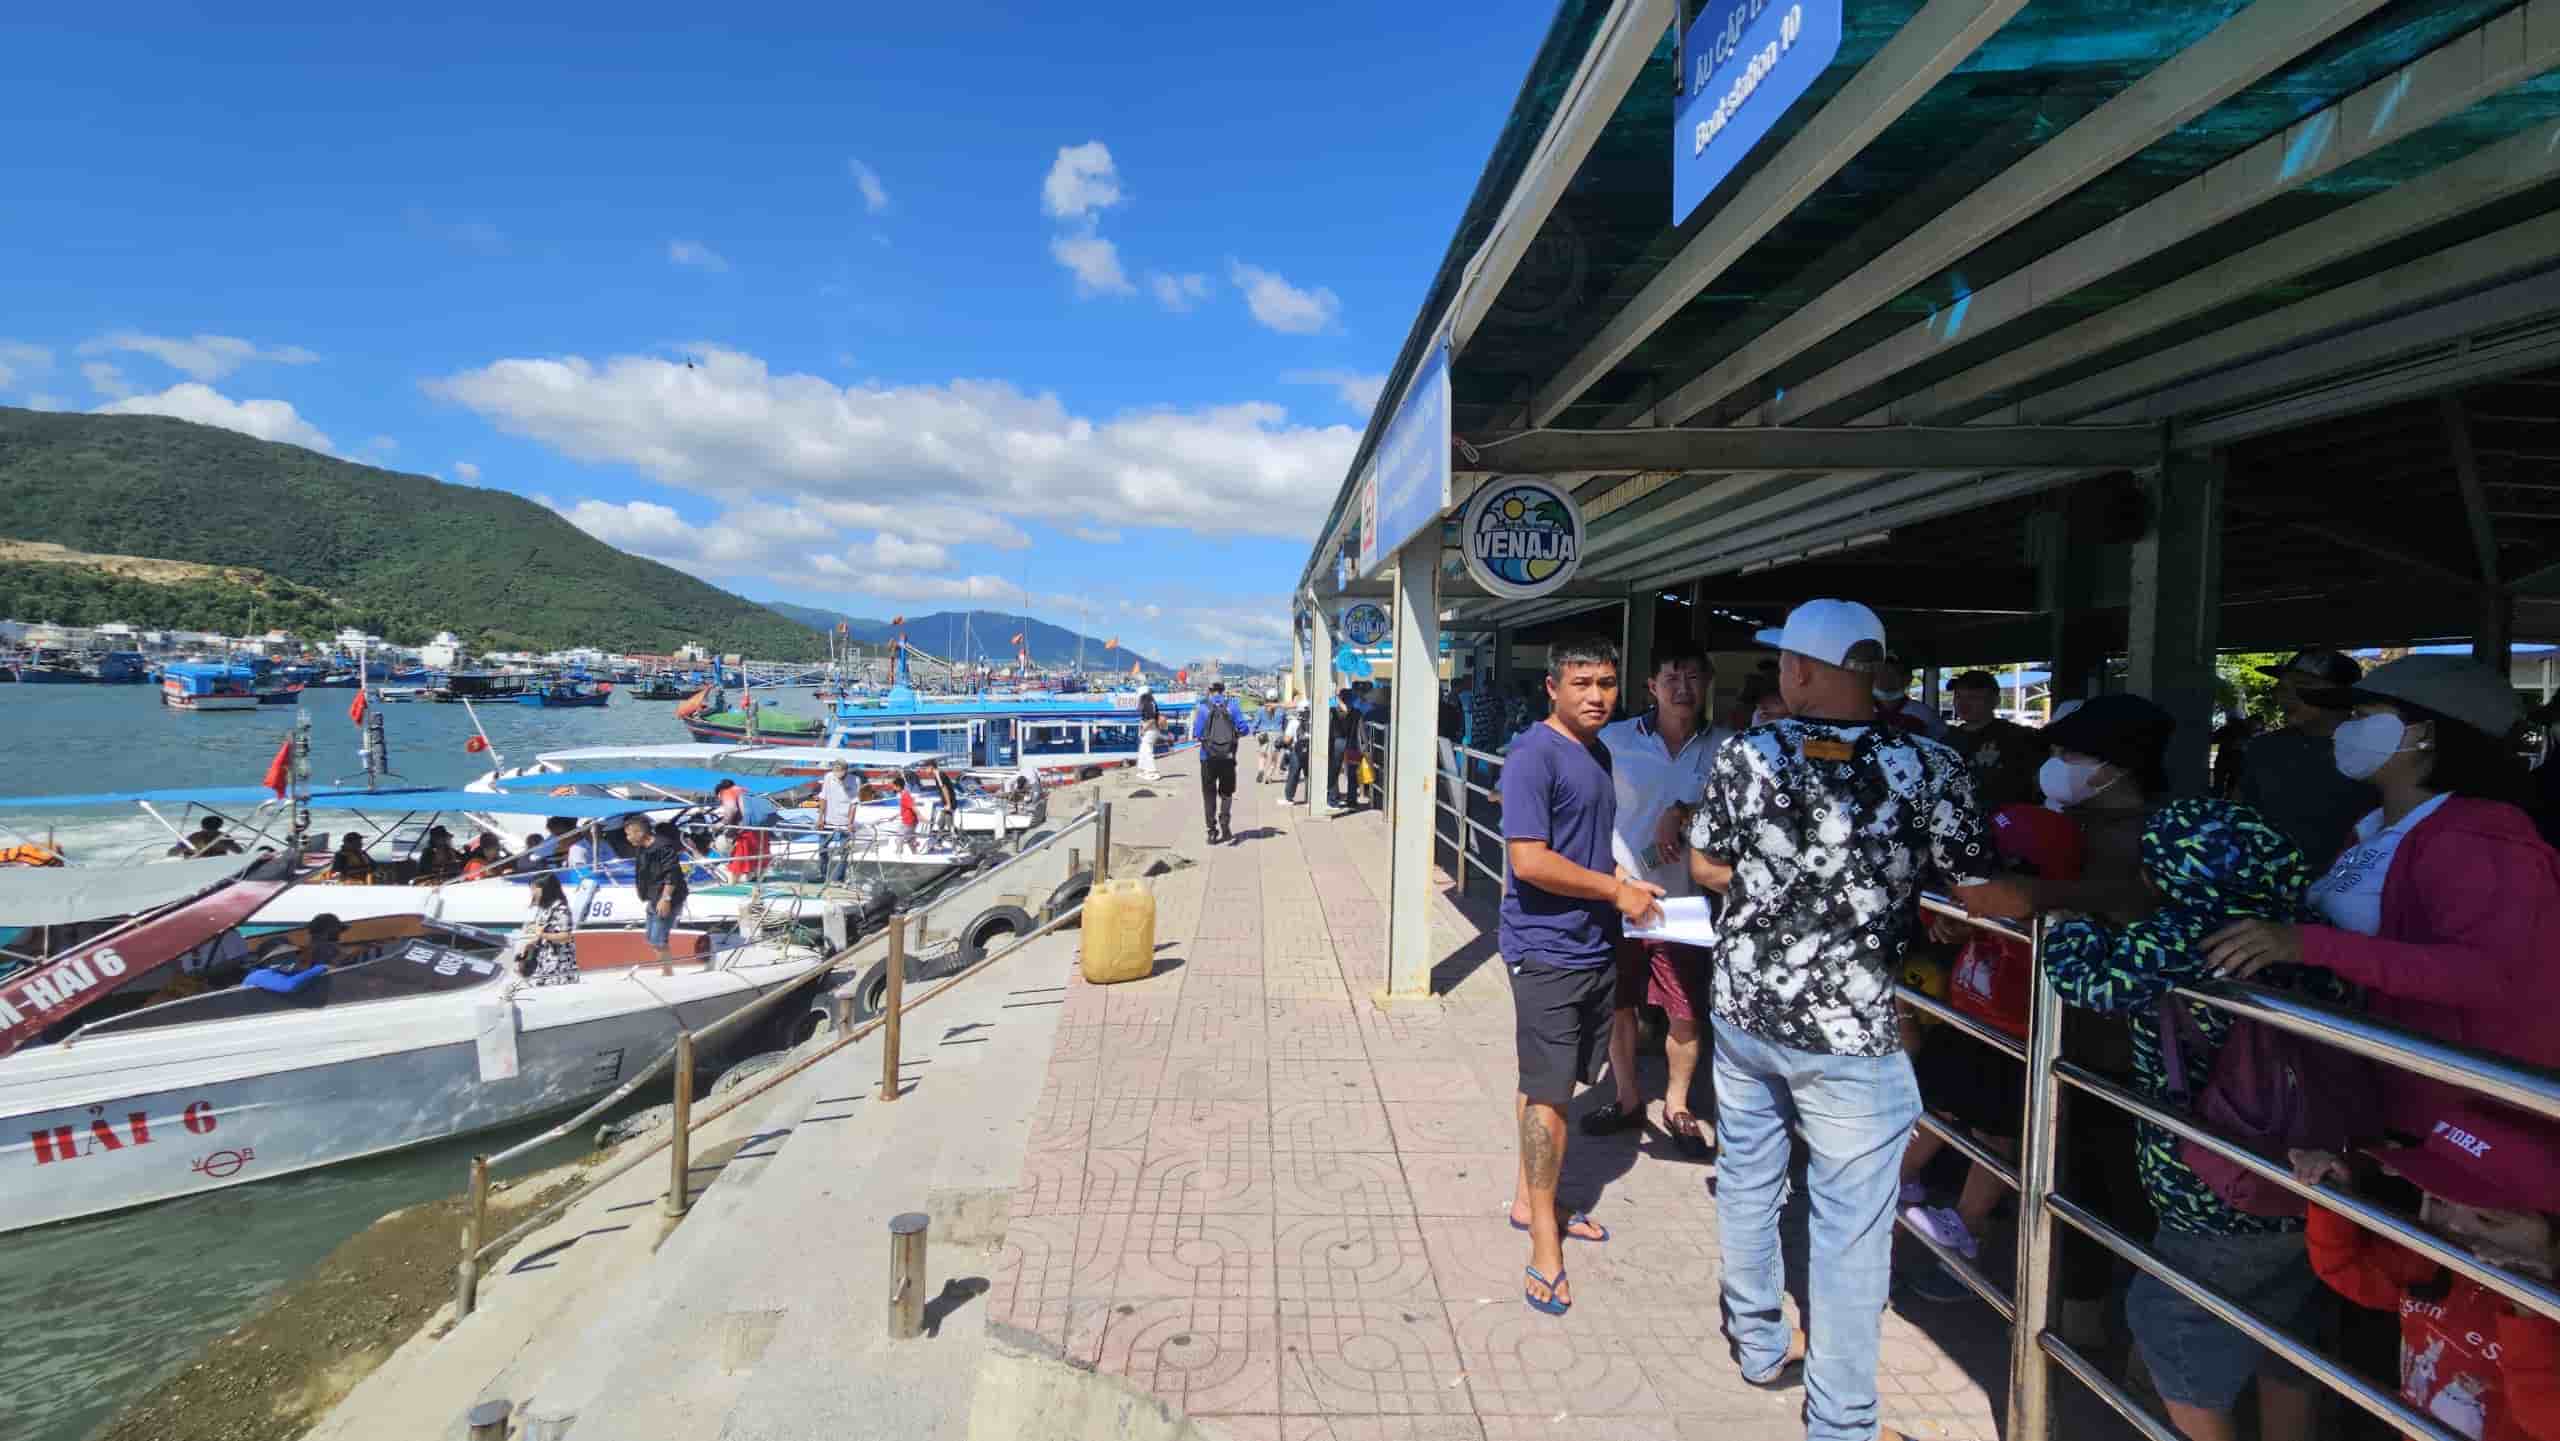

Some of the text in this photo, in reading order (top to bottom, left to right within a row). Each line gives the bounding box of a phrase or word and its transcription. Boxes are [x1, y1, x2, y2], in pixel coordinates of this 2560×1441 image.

[1779, 4, 1801, 50] 10
[1474, 529, 1576, 561] VENAJA
[93, 948, 127, 977] 6
[29, 1100, 217, 1167] HẢI 6
